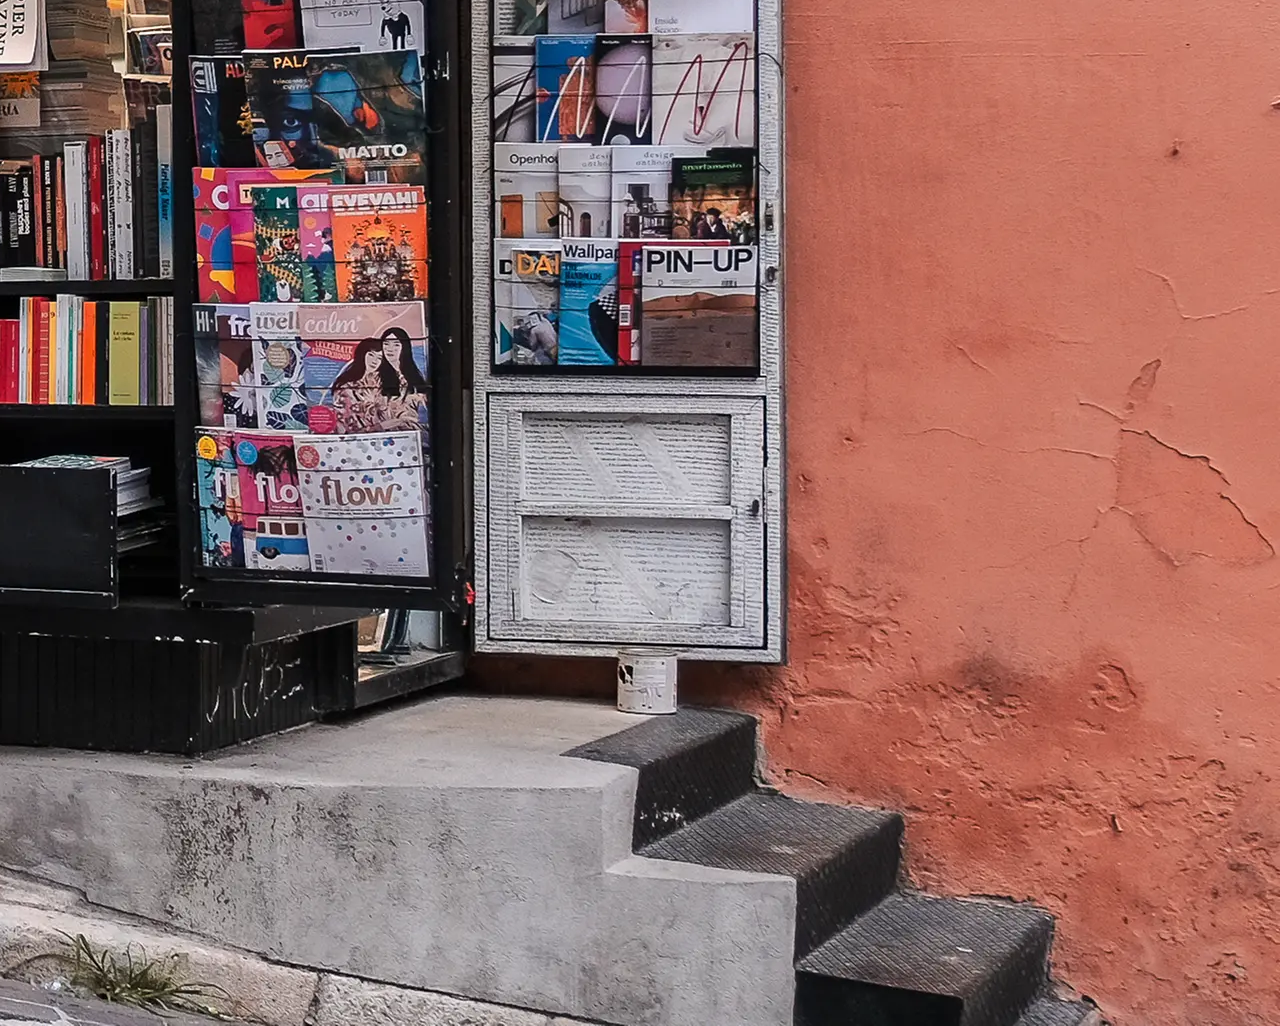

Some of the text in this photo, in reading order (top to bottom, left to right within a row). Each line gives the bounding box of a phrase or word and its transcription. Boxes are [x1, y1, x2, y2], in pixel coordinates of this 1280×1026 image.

[331, 9, 361, 19] TODAY
[338, 143, 408, 160] MATTO
[643, 151, 675, 160] design
[681, 161, 743, 172] apartamento
[256, 312, 299, 331] well
[304, 311, 358, 334] calm
[311, 347, 353, 362] SISTERHOOD
[314, 340, 354, 354] CELEBRATE
[321, 475, 401, 507] flow
